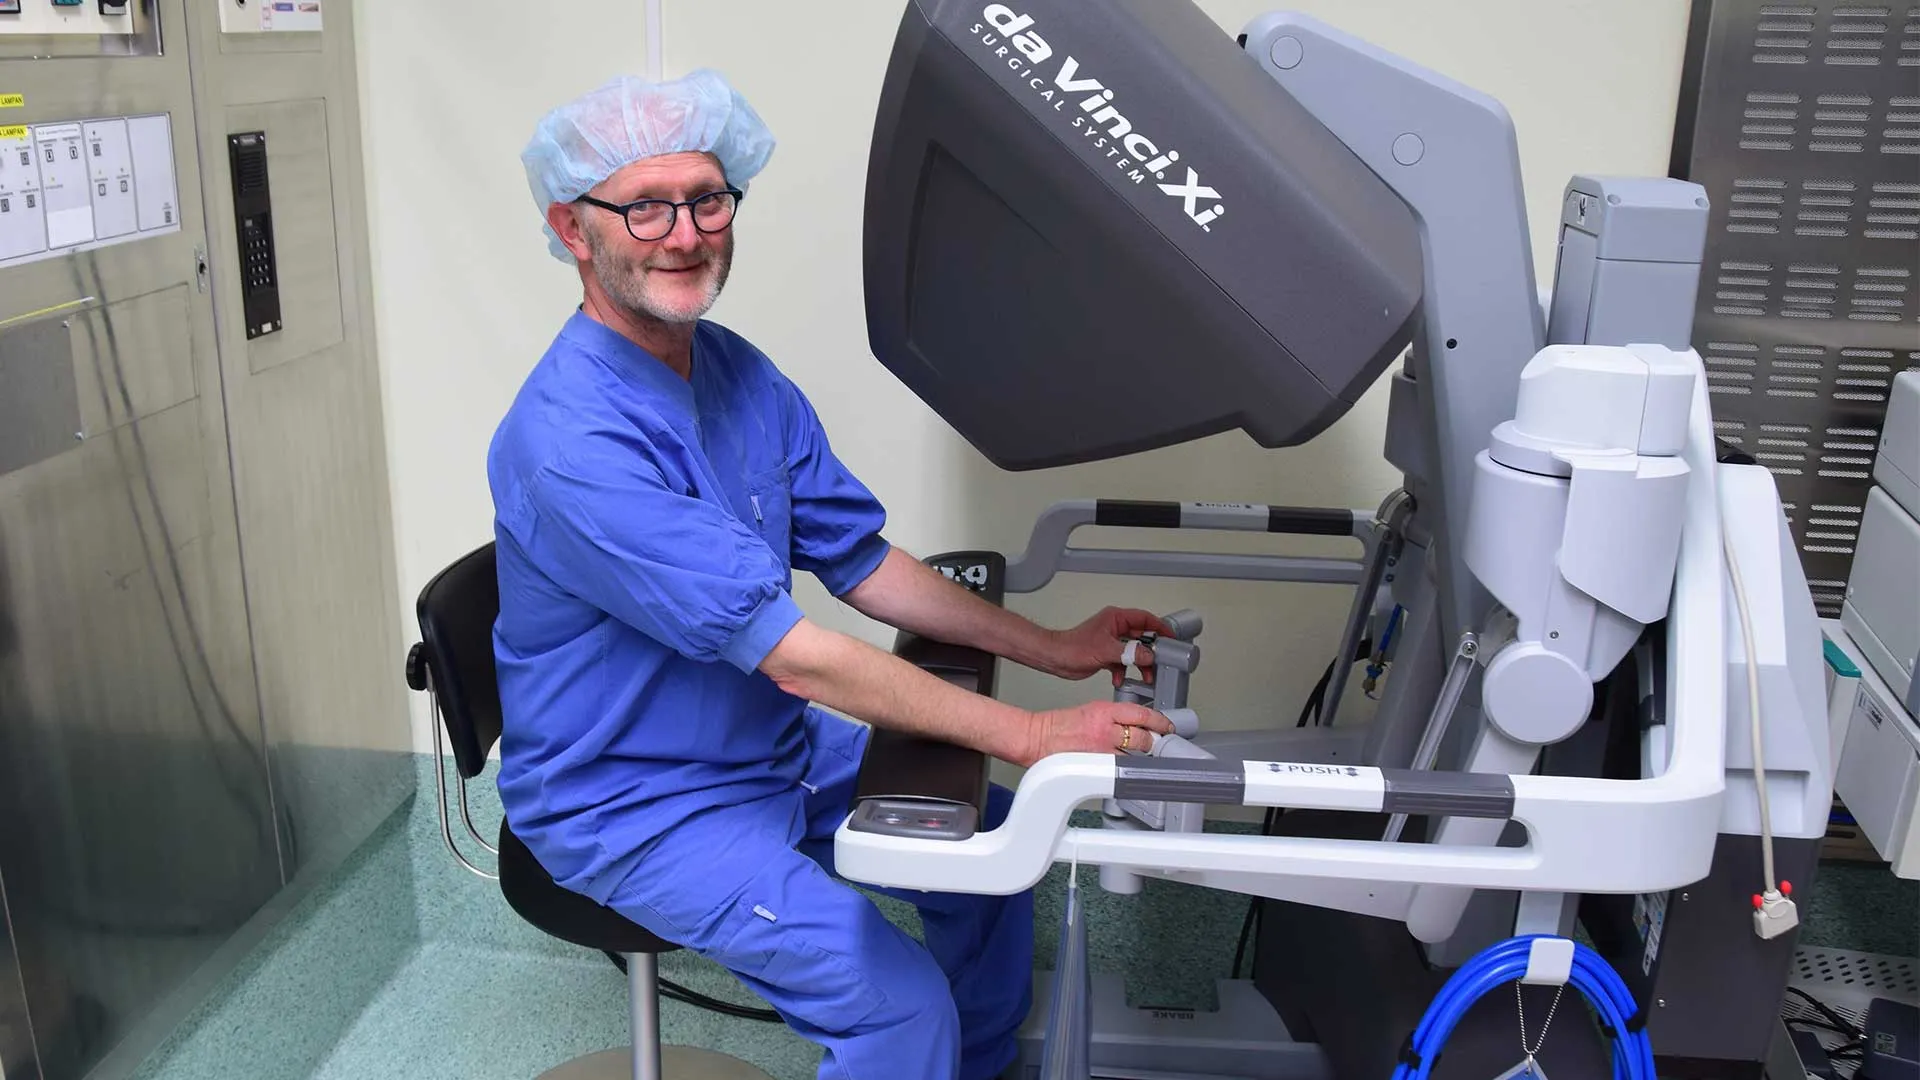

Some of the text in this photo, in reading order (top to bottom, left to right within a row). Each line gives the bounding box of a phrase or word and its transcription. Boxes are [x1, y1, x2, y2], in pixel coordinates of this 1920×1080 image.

[970, 23, 1145, 184] SURGICAL SYSTEM
[983, 4, 1225, 227] da Vinci Xi
[1288, 765, 1341, 775] PUSH
